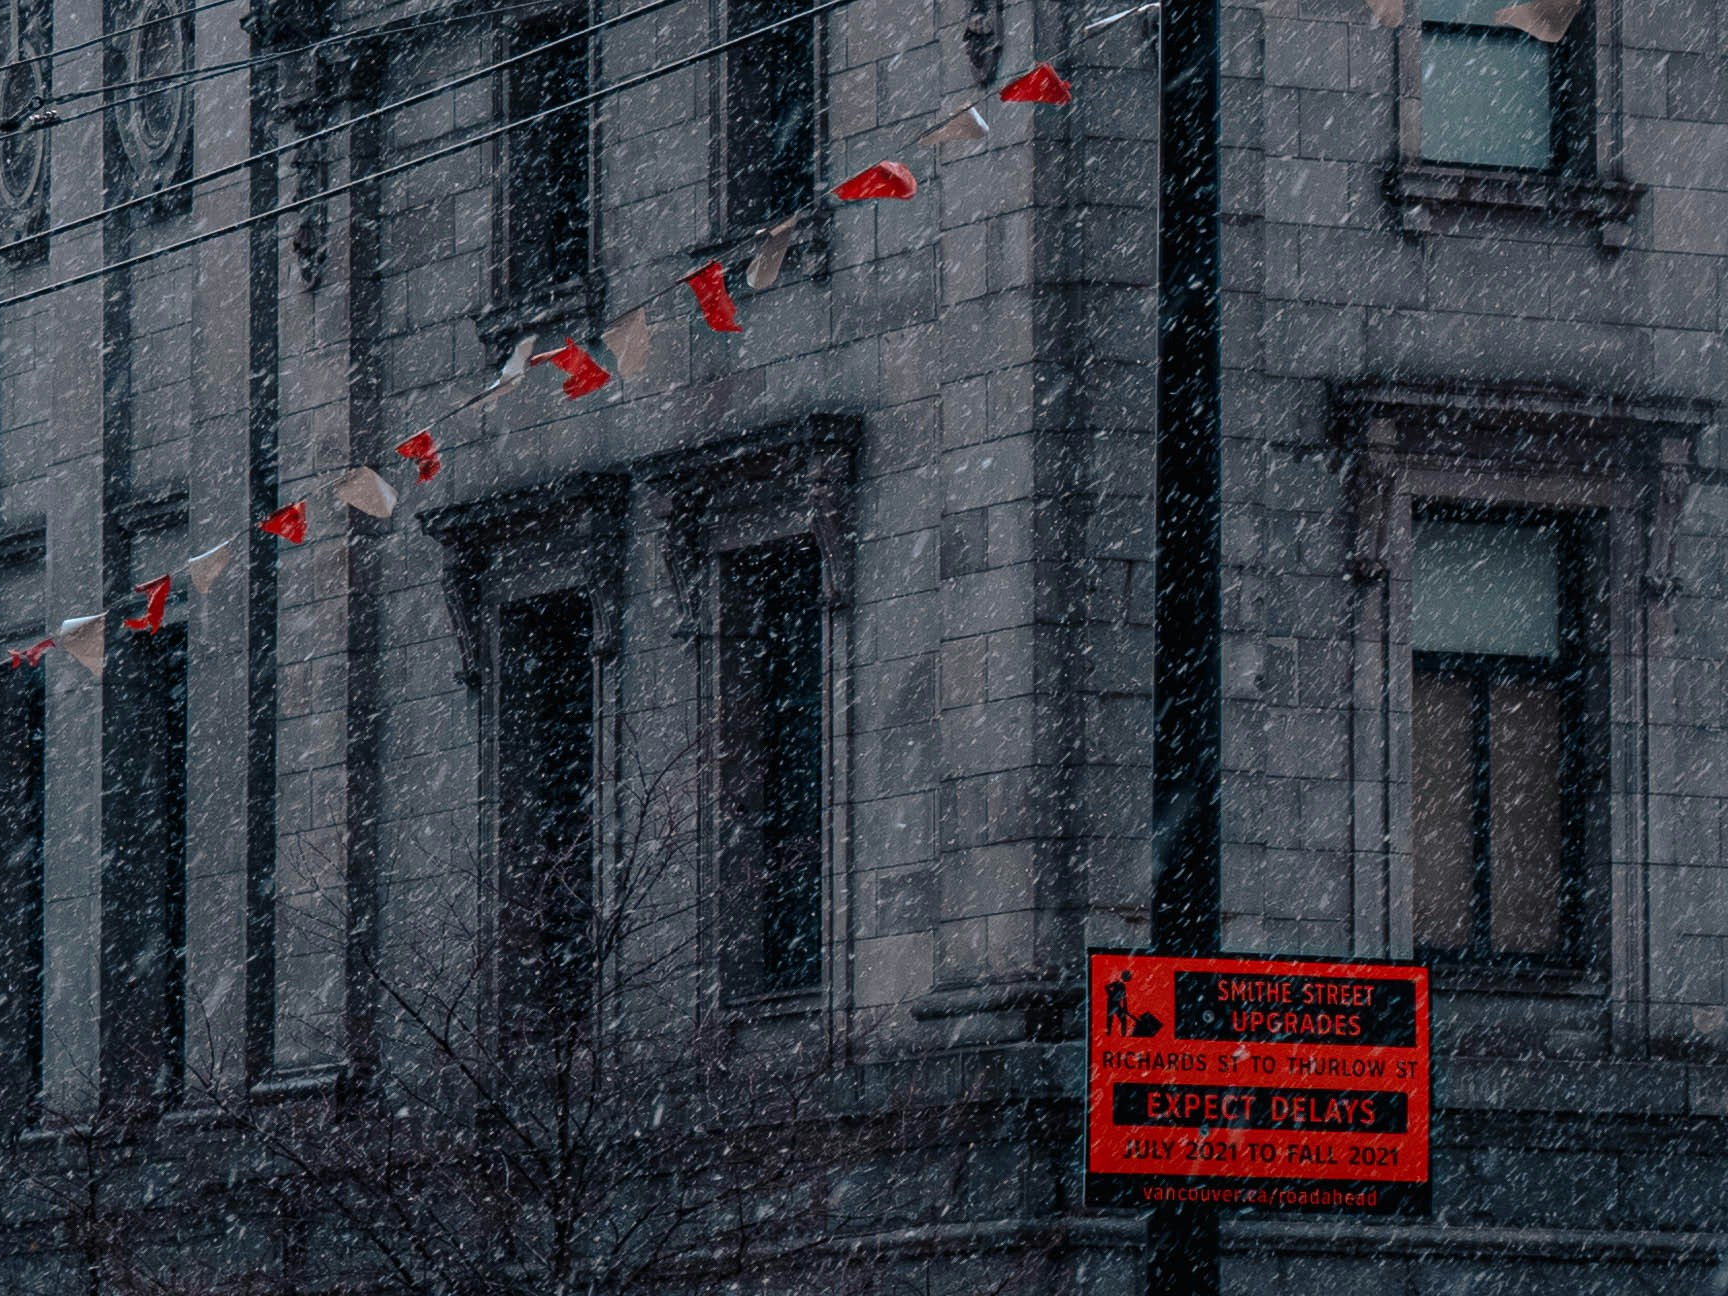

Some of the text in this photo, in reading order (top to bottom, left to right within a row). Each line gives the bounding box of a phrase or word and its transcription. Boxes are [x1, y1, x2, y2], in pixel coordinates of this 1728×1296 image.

[1217, 979, 1375, 1007] SMITHE STREET
[1232, 1010, 1361, 1036] UPGRADES
[1102, 1050, 1417, 1079] RICHARDS ST TO THURLOW ST
[1146, 1091, 1377, 1125] EXPECT DELAYS
[1123, 1140, 1399, 1167] JULY 2021 TO FALL 2021
[1143, 1184, 1377, 1207] vancouver.ca/roadahead
